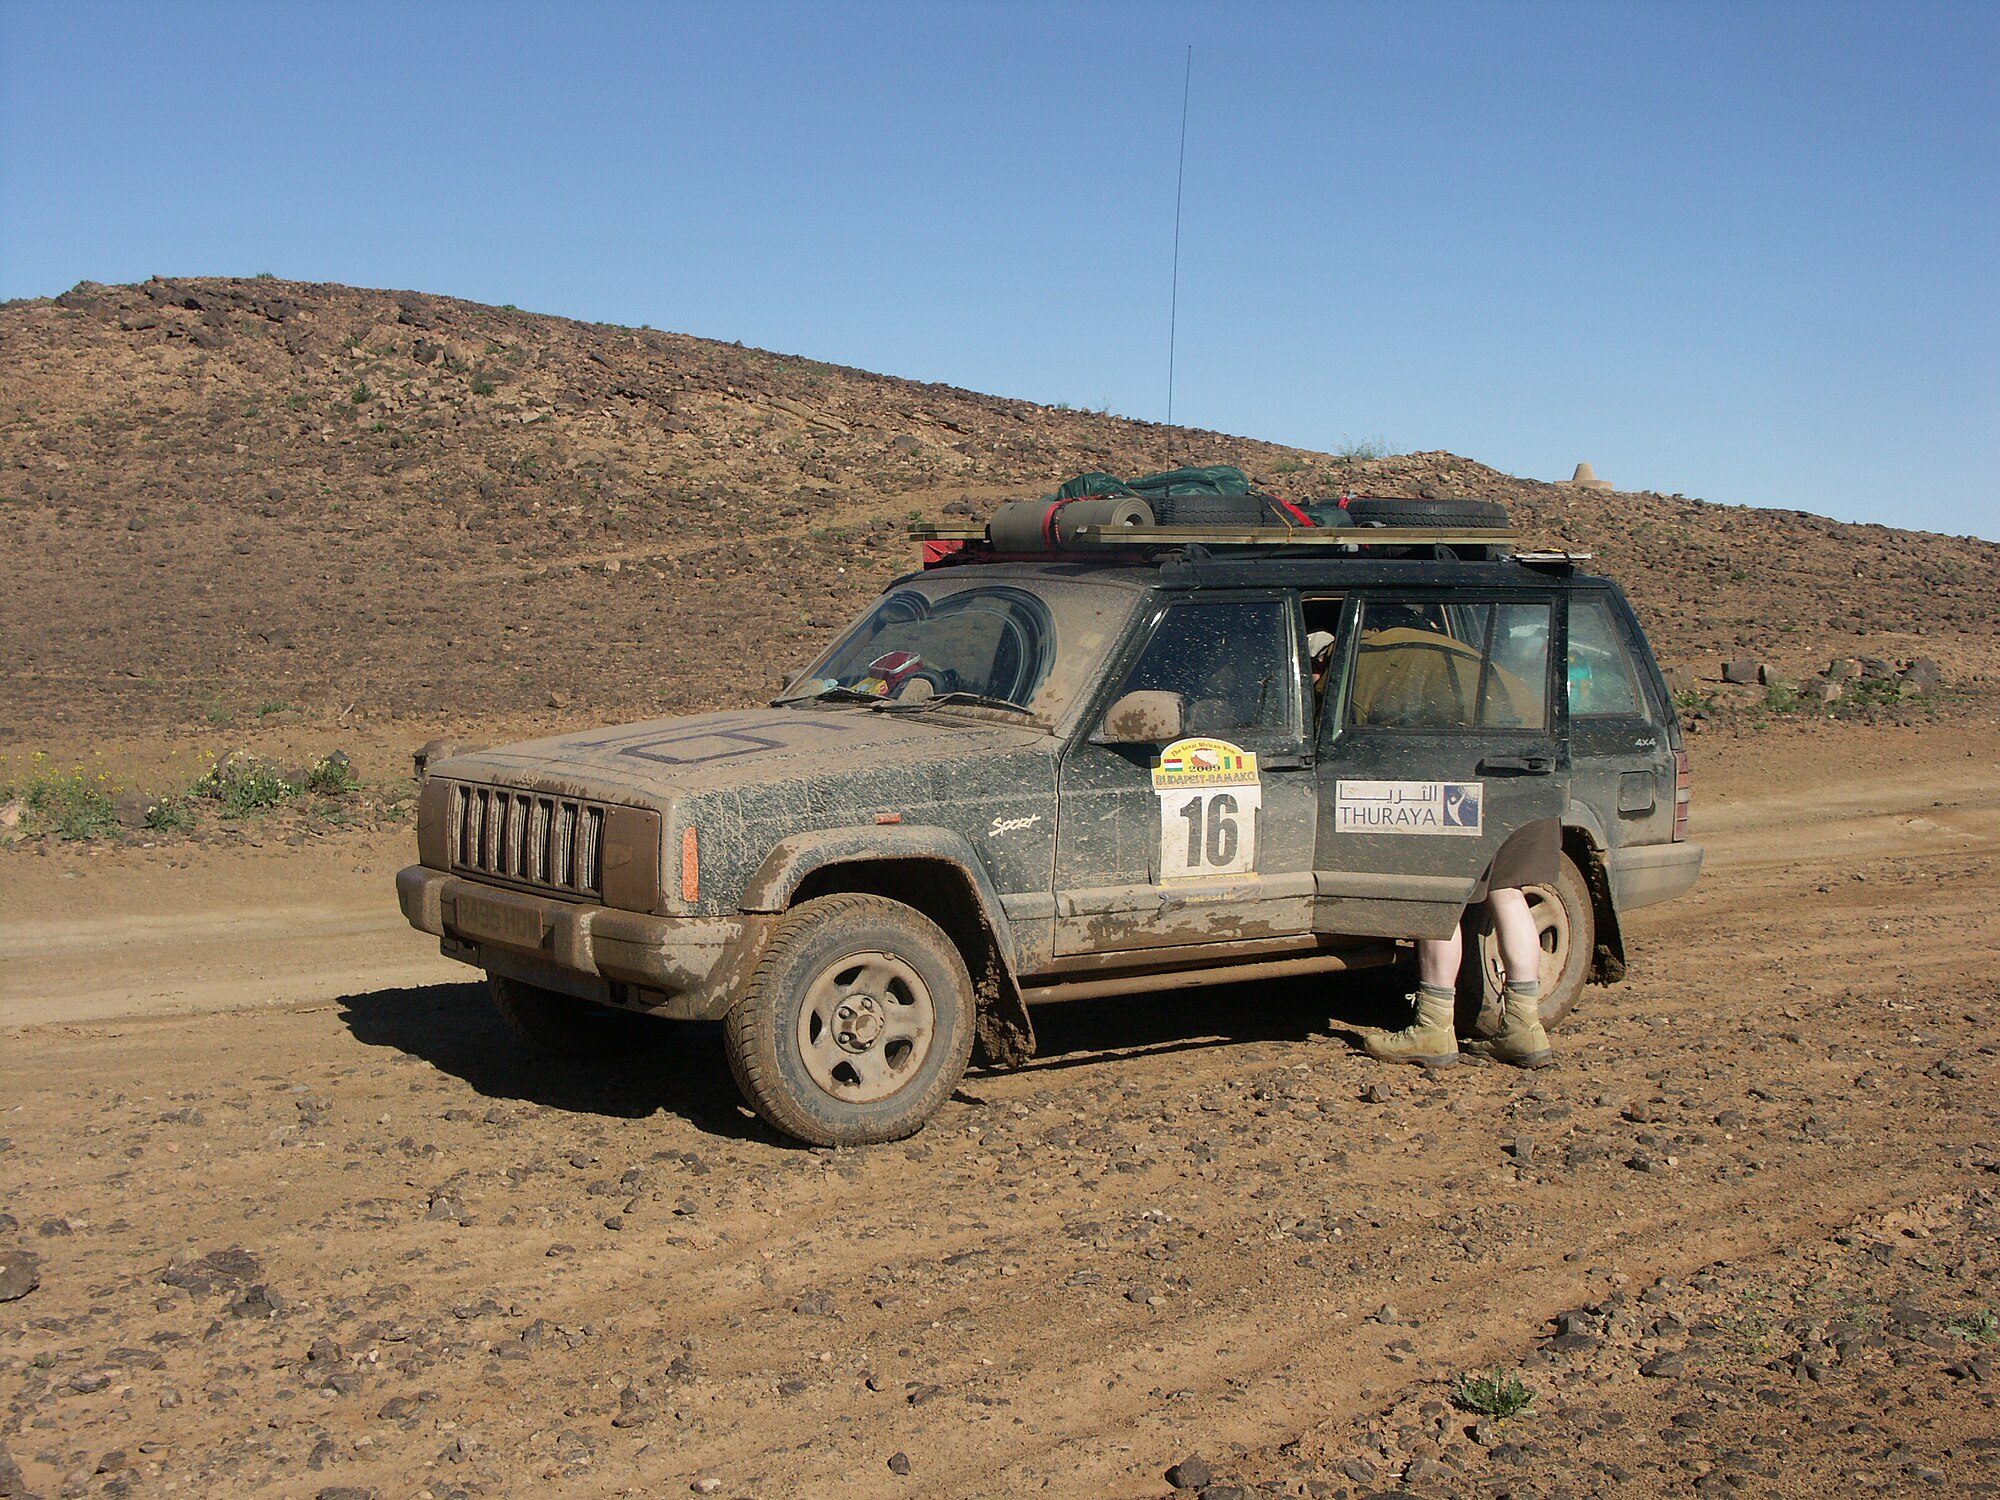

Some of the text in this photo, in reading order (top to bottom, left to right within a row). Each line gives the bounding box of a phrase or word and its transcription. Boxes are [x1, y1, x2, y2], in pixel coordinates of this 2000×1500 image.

[1635, 737, 1656, 746] 4x4
[515, 769, 540, 789] Jeep
[1189, 765, 1221, 773] 2009
[988, 813, 1041, 837] Sport
[1339, 806, 1437, 826] THURAYA
[1180, 793, 1240, 868] 16
